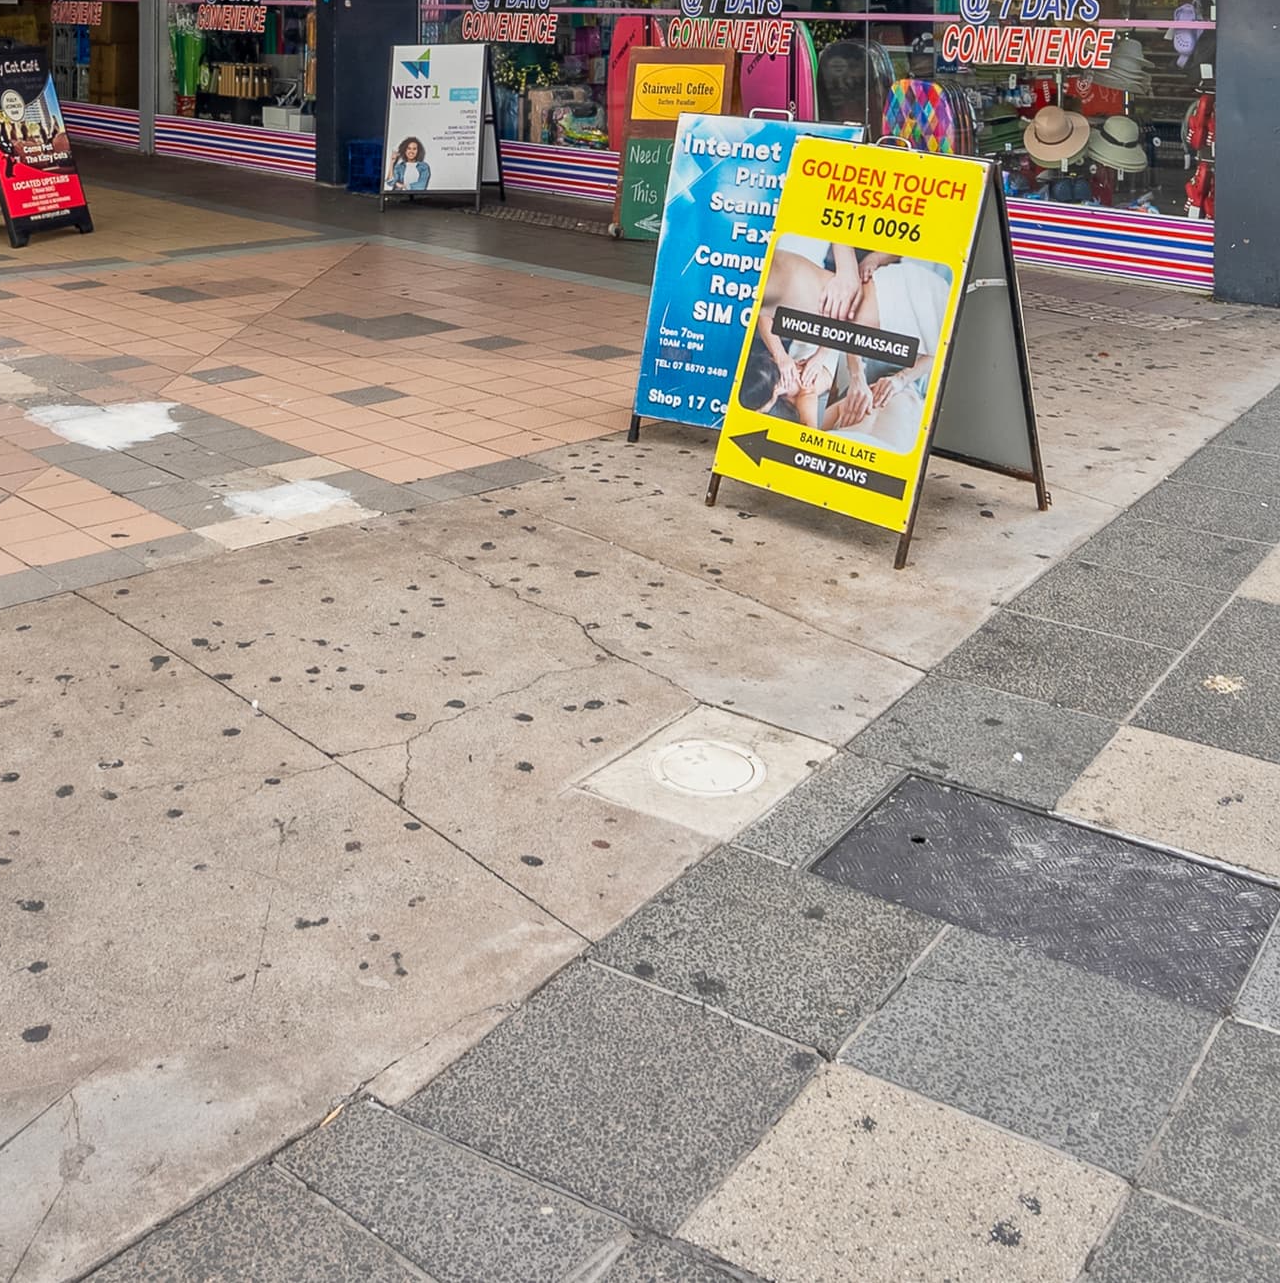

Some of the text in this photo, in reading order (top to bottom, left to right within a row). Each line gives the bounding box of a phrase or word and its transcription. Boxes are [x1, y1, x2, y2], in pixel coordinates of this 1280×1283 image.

[196, 4, 268, 33] CONVENIENCE
[462, 10, 558, 44] CONVENIENCE
[668, 17, 794, 56] CONVENIENCE
[941, 24, 1116, 69] CONVENIENCE
[4, 61, 20, 74] Cat
[20, 59, 40, 72] Café
[642, 81, 715, 96] Stairwell Coffee
[630, 145, 662, 164] Need
[684, 133, 782, 162] Internet
[12, 175, 70, 190] LOCATED UPSTAIRS
[632, 181, 657, 204] This
[802, 159, 967, 202] GOLDEN TOUCH
[710, 192, 778, 218] Scanni
[826, 184, 927, 216] MASSAGE
[821, 208, 921, 242] 5511 0096
[695, 245, 765, 272] Compu
[710, 275, 760, 300] Repa
[693, 300, 732, 324] SIM
[660, 326, 678, 338] Open
[782, 316, 910, 358] WHOLE BODY MASSAGE
[656, 359, 670, 370] TEL:
[672, 360, 683, 370] 07
[684, 362, 706, 374] 5570
[648, 389, 682, 408] Shop
[687, 393, 706, 410] 17
[799, 432, 876, 464] 8AM TILL LATE
[794, 452, 868, 484] OPEN 7 DAYS
